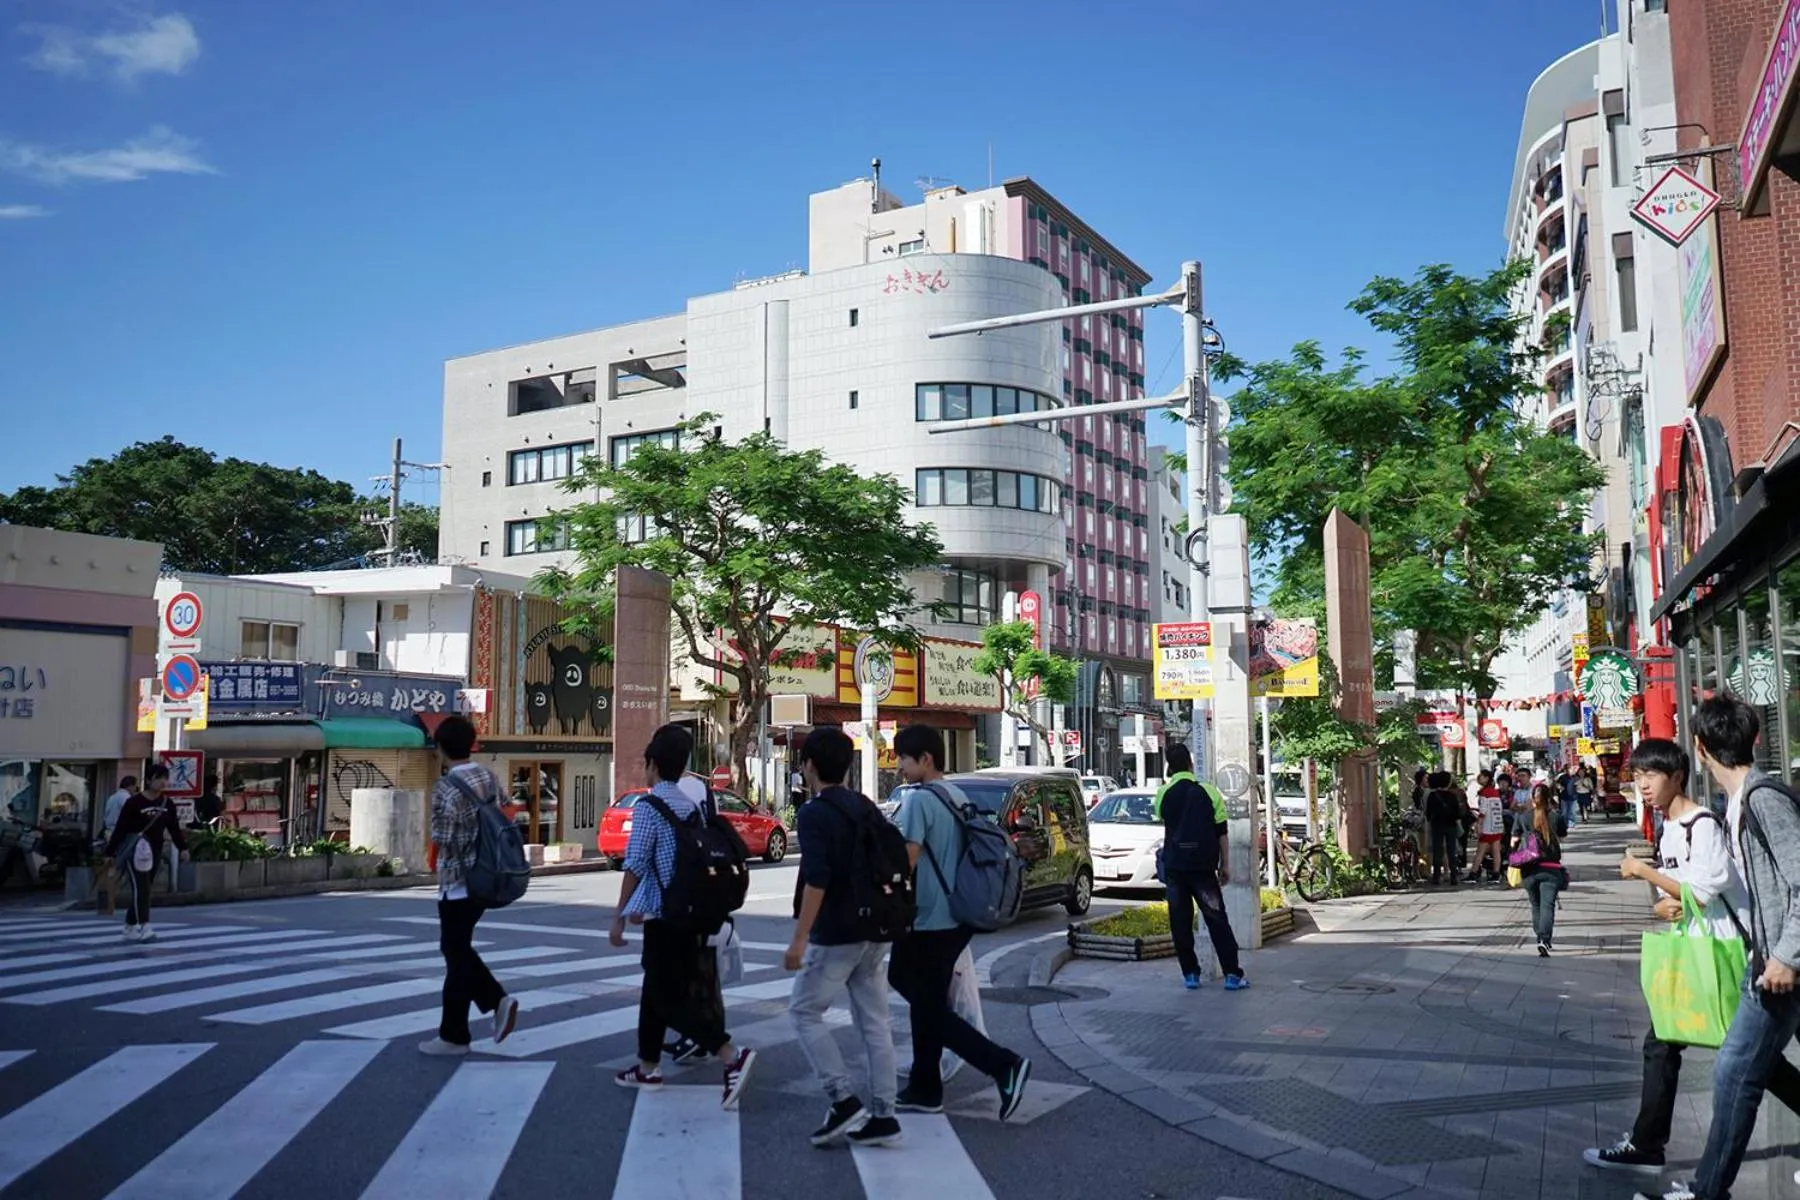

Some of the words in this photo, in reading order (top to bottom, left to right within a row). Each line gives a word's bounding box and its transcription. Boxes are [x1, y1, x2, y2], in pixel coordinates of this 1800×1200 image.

[173, 605, 194, 625] 30
[390, 688, 446, 712] かどや
